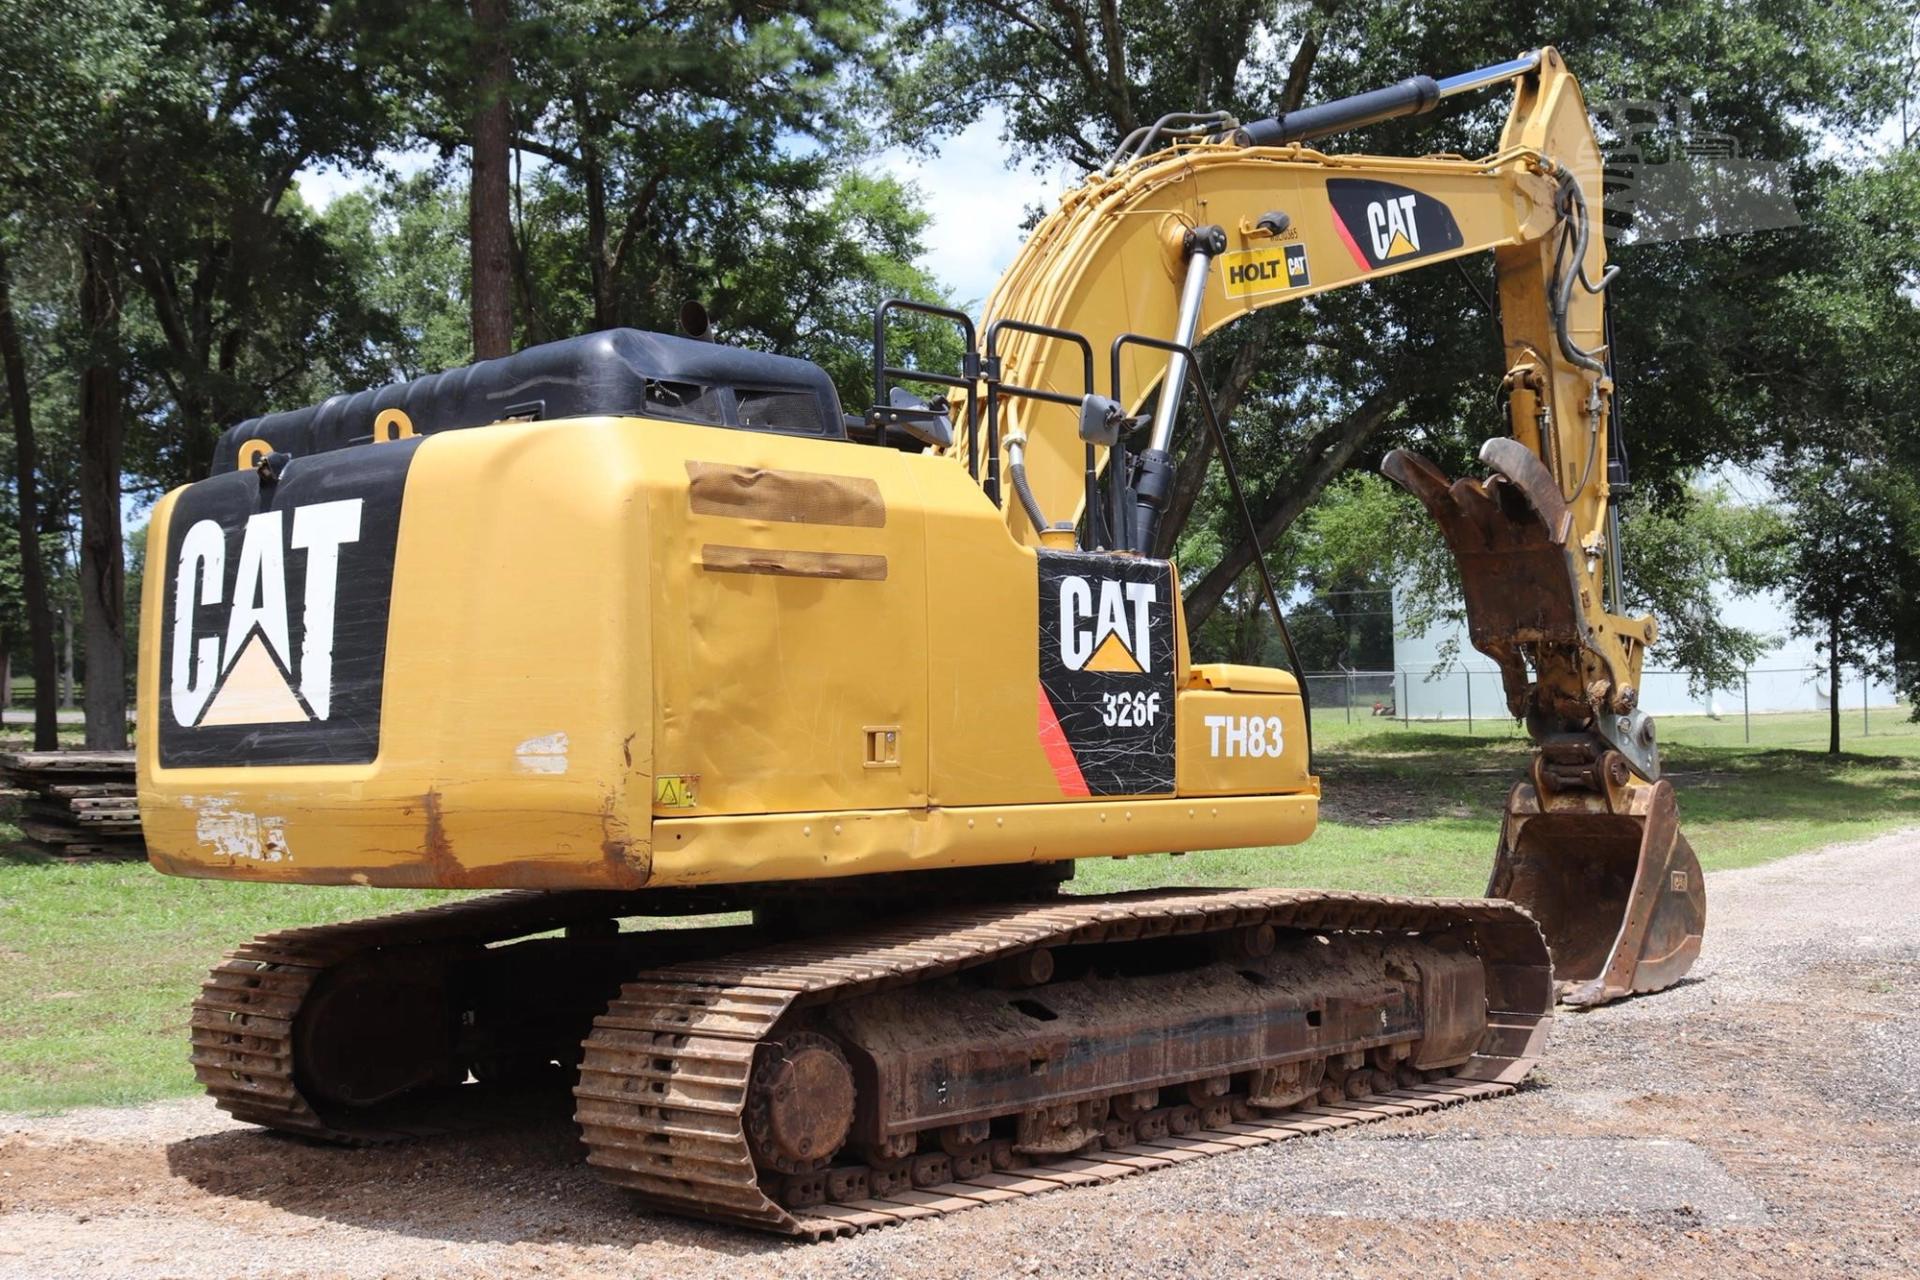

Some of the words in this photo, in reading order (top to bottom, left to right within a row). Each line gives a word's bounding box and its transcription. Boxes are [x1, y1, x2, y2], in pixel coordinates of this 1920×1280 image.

[1366, 194, 1420, 260] CAT
[1230, 260, 1280, 285] HOLT
[1287, 255, 1305, 277] CAT
[170, 498, 364, 729] CAT
[1059, 575, 1156, 674] CAT
[1102, 690, 1160, 728] 326F
[1204, 715, 1285, 758] TH83
